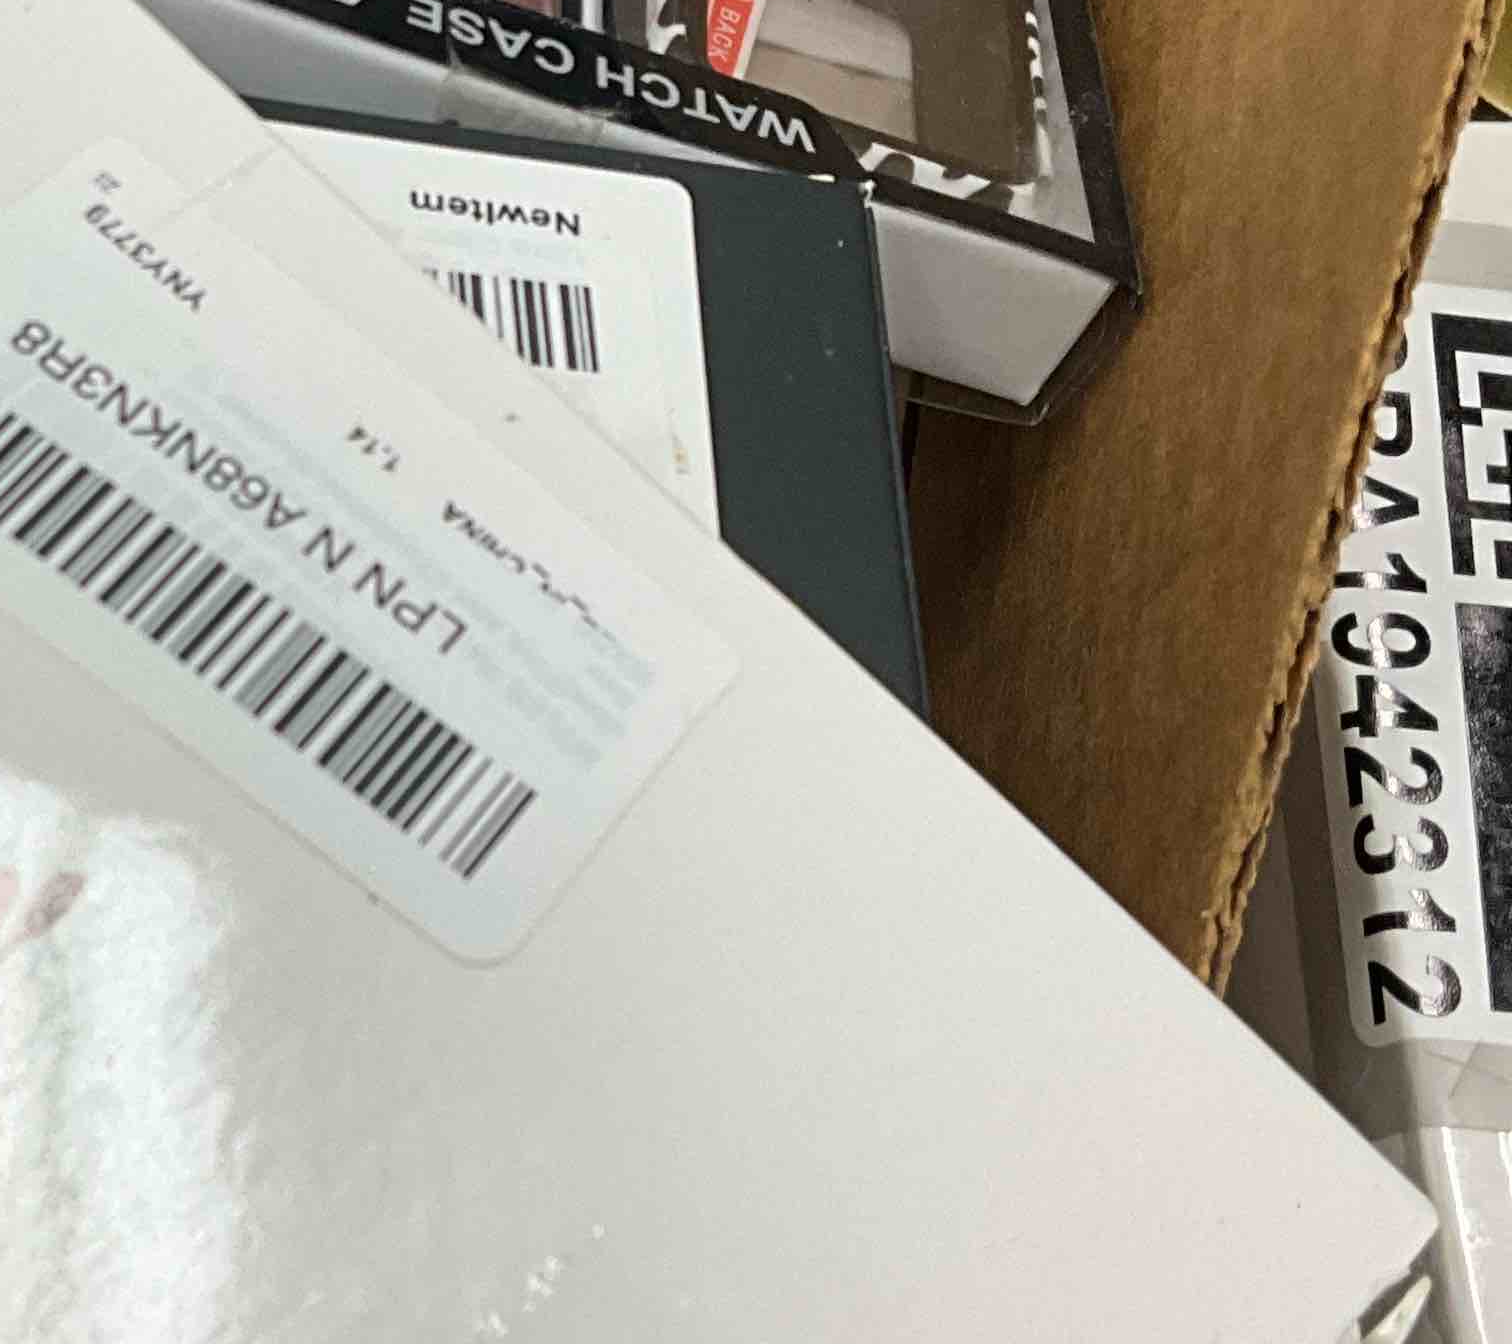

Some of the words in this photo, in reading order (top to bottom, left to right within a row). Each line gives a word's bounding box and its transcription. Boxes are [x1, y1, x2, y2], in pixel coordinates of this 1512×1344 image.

[710, 6, 742, 61] BACK
[595, 53, 817, 154] WATCH
[410, 188, 582, 238] NewItem
[10, 318, 307, 539] A68NKN3R8
[302, 524, 364, 584] N
[353, 561, 469, 657] LPN
[1331, 331, 1464, 1028] RA1942312
